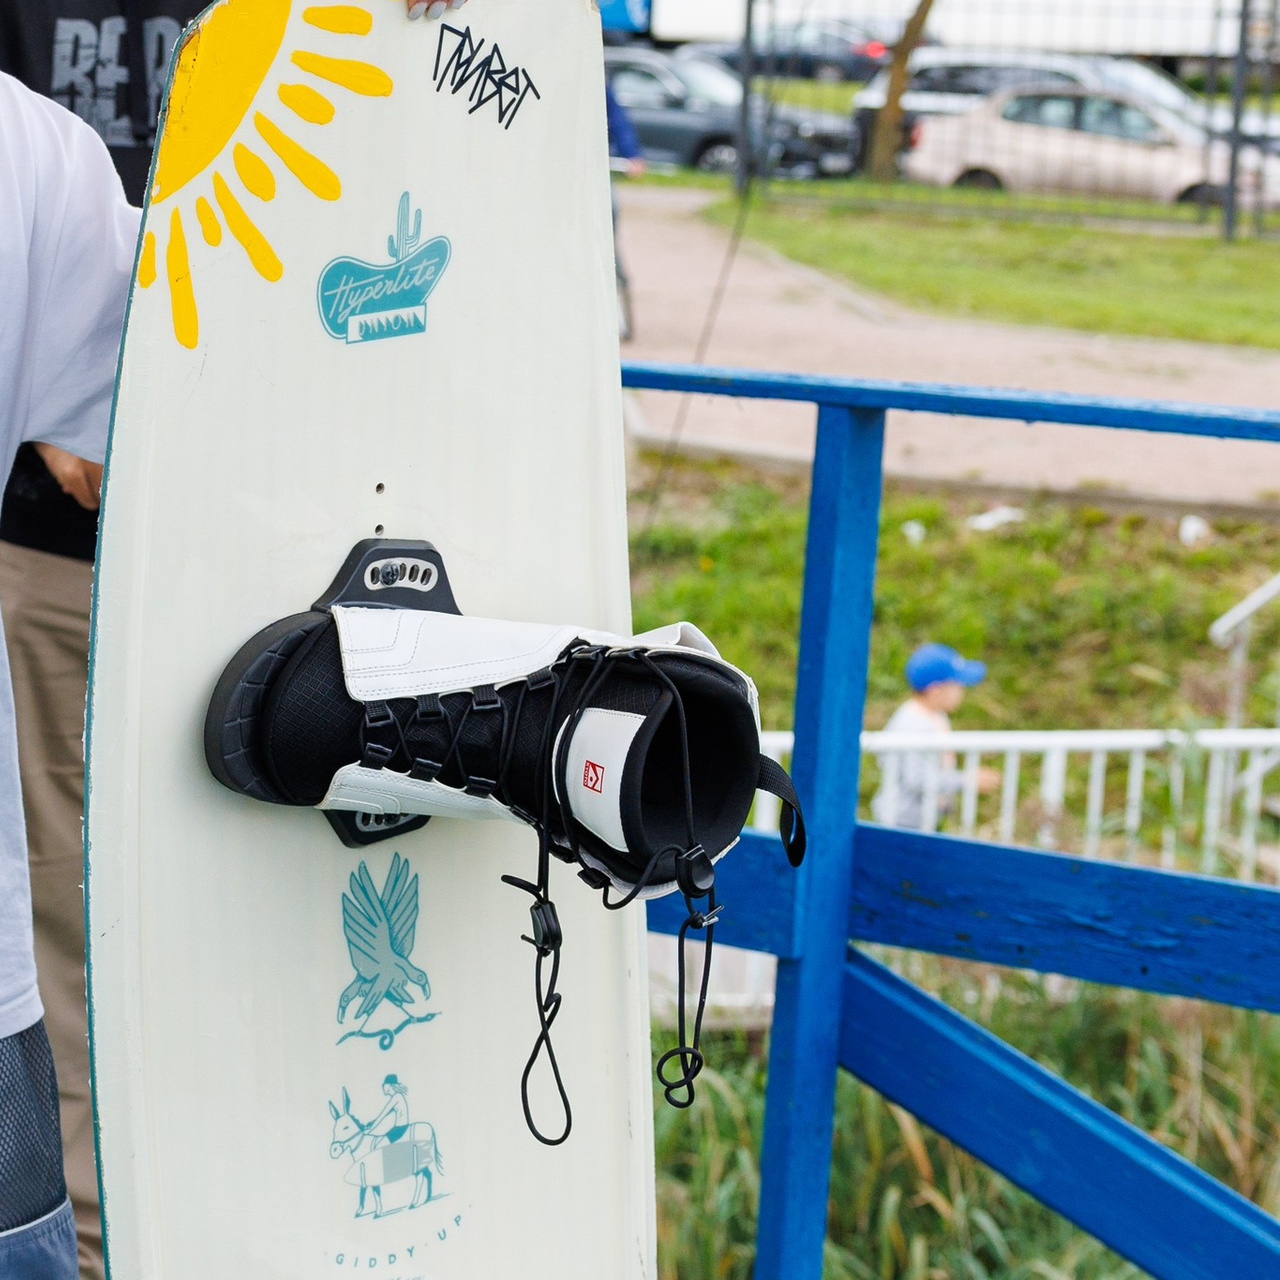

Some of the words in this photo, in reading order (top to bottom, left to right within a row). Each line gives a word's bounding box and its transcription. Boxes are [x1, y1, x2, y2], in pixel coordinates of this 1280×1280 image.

[324, 258, 440, 324] Hyperlite
[336, 1246, 415, 1268] GIDDY
[437, 1215, 462, 1241] UP
